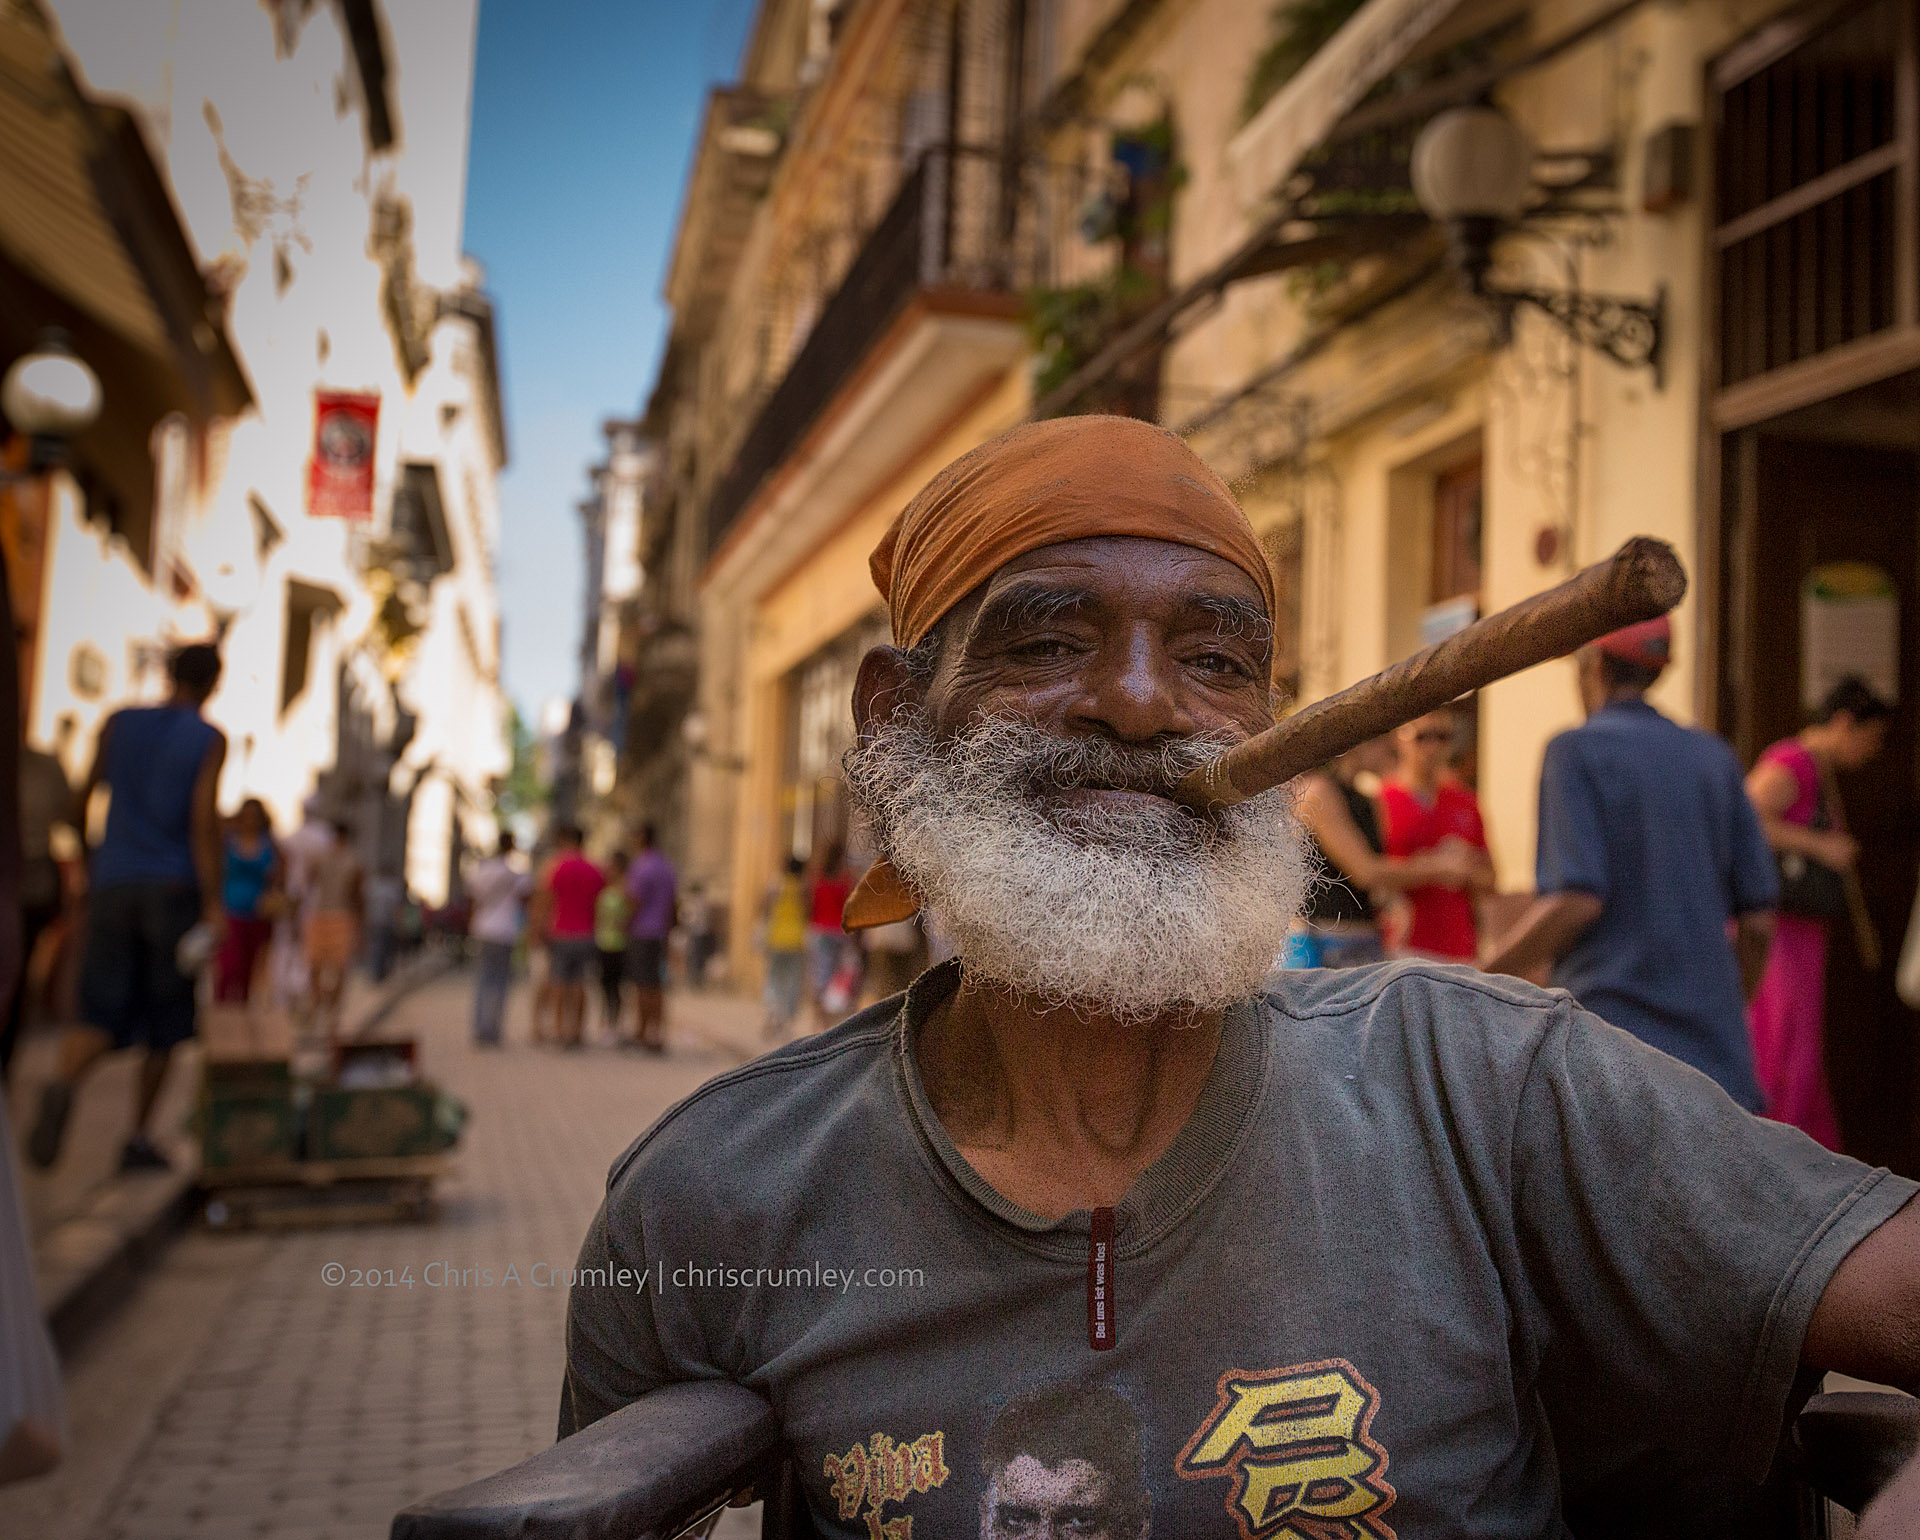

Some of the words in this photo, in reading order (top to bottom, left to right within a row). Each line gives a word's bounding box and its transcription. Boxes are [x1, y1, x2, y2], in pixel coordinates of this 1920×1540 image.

[1095, 1242, 1106, 1262] los!
[1096, 1262, 1106, 1286] was
[1094, 1286, 1105, 1300] ist
[1096, 1301, 1105, 1321] uns
[1095, 1322, 1106, 1339] Bei
